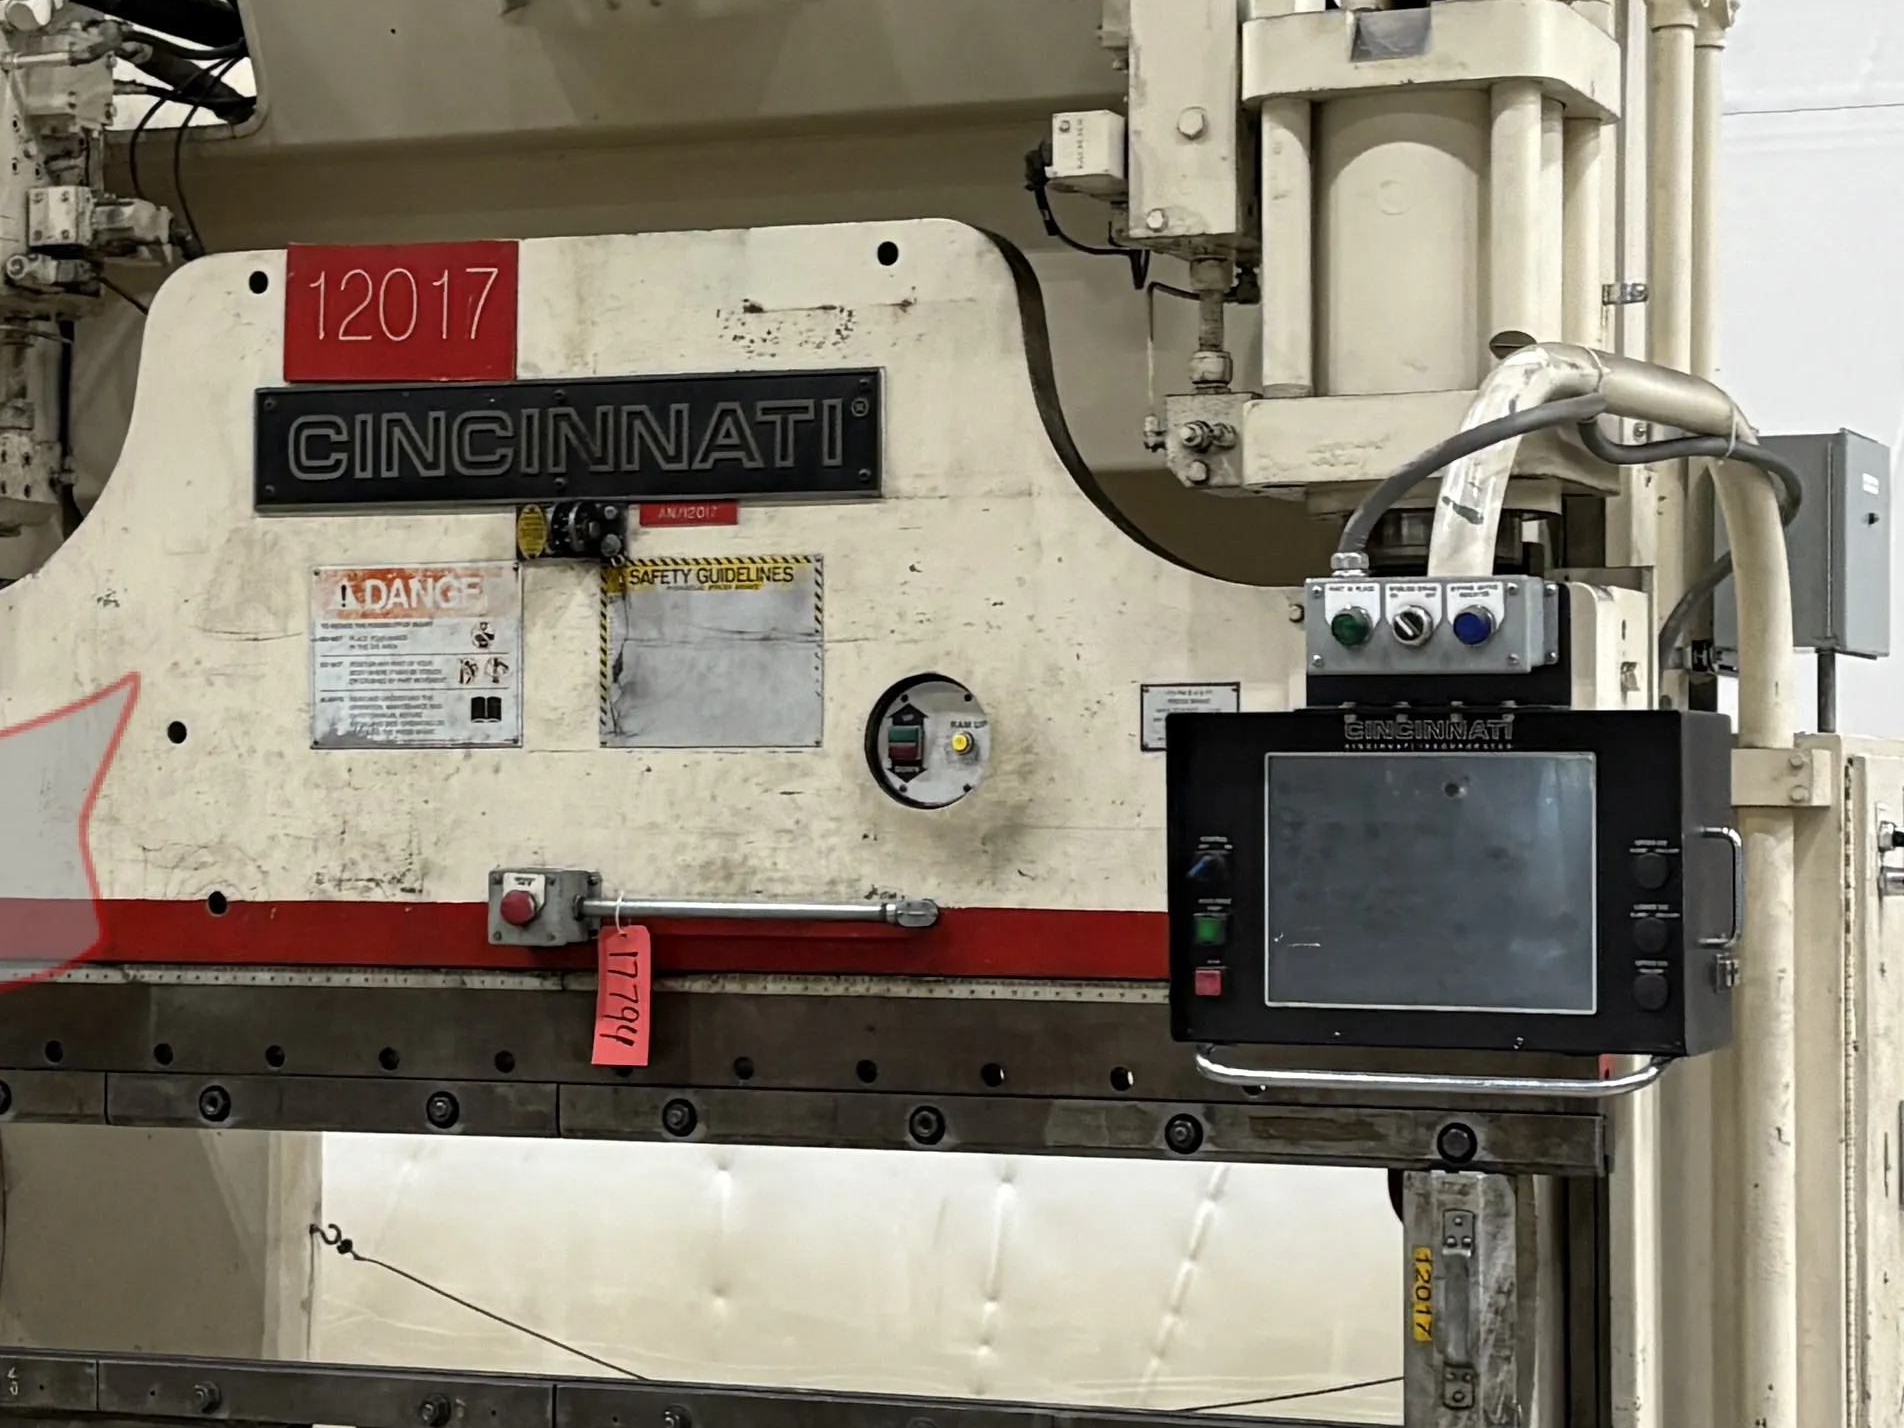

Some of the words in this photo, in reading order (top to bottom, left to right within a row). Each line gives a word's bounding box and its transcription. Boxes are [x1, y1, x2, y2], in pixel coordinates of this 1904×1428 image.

[308, 267, 500, 343] 12017
[287, 397, 844, 481] CINCINNATI
[629, 568, 692, 585] SAFETY
[697, 566, 794, 584] GUIDELINES
[1344, 720, 1513, 740] CINCINNATI
[599, 951, 640, 1047] 17794
[1416, 1254, 1432, 1338] 12017
